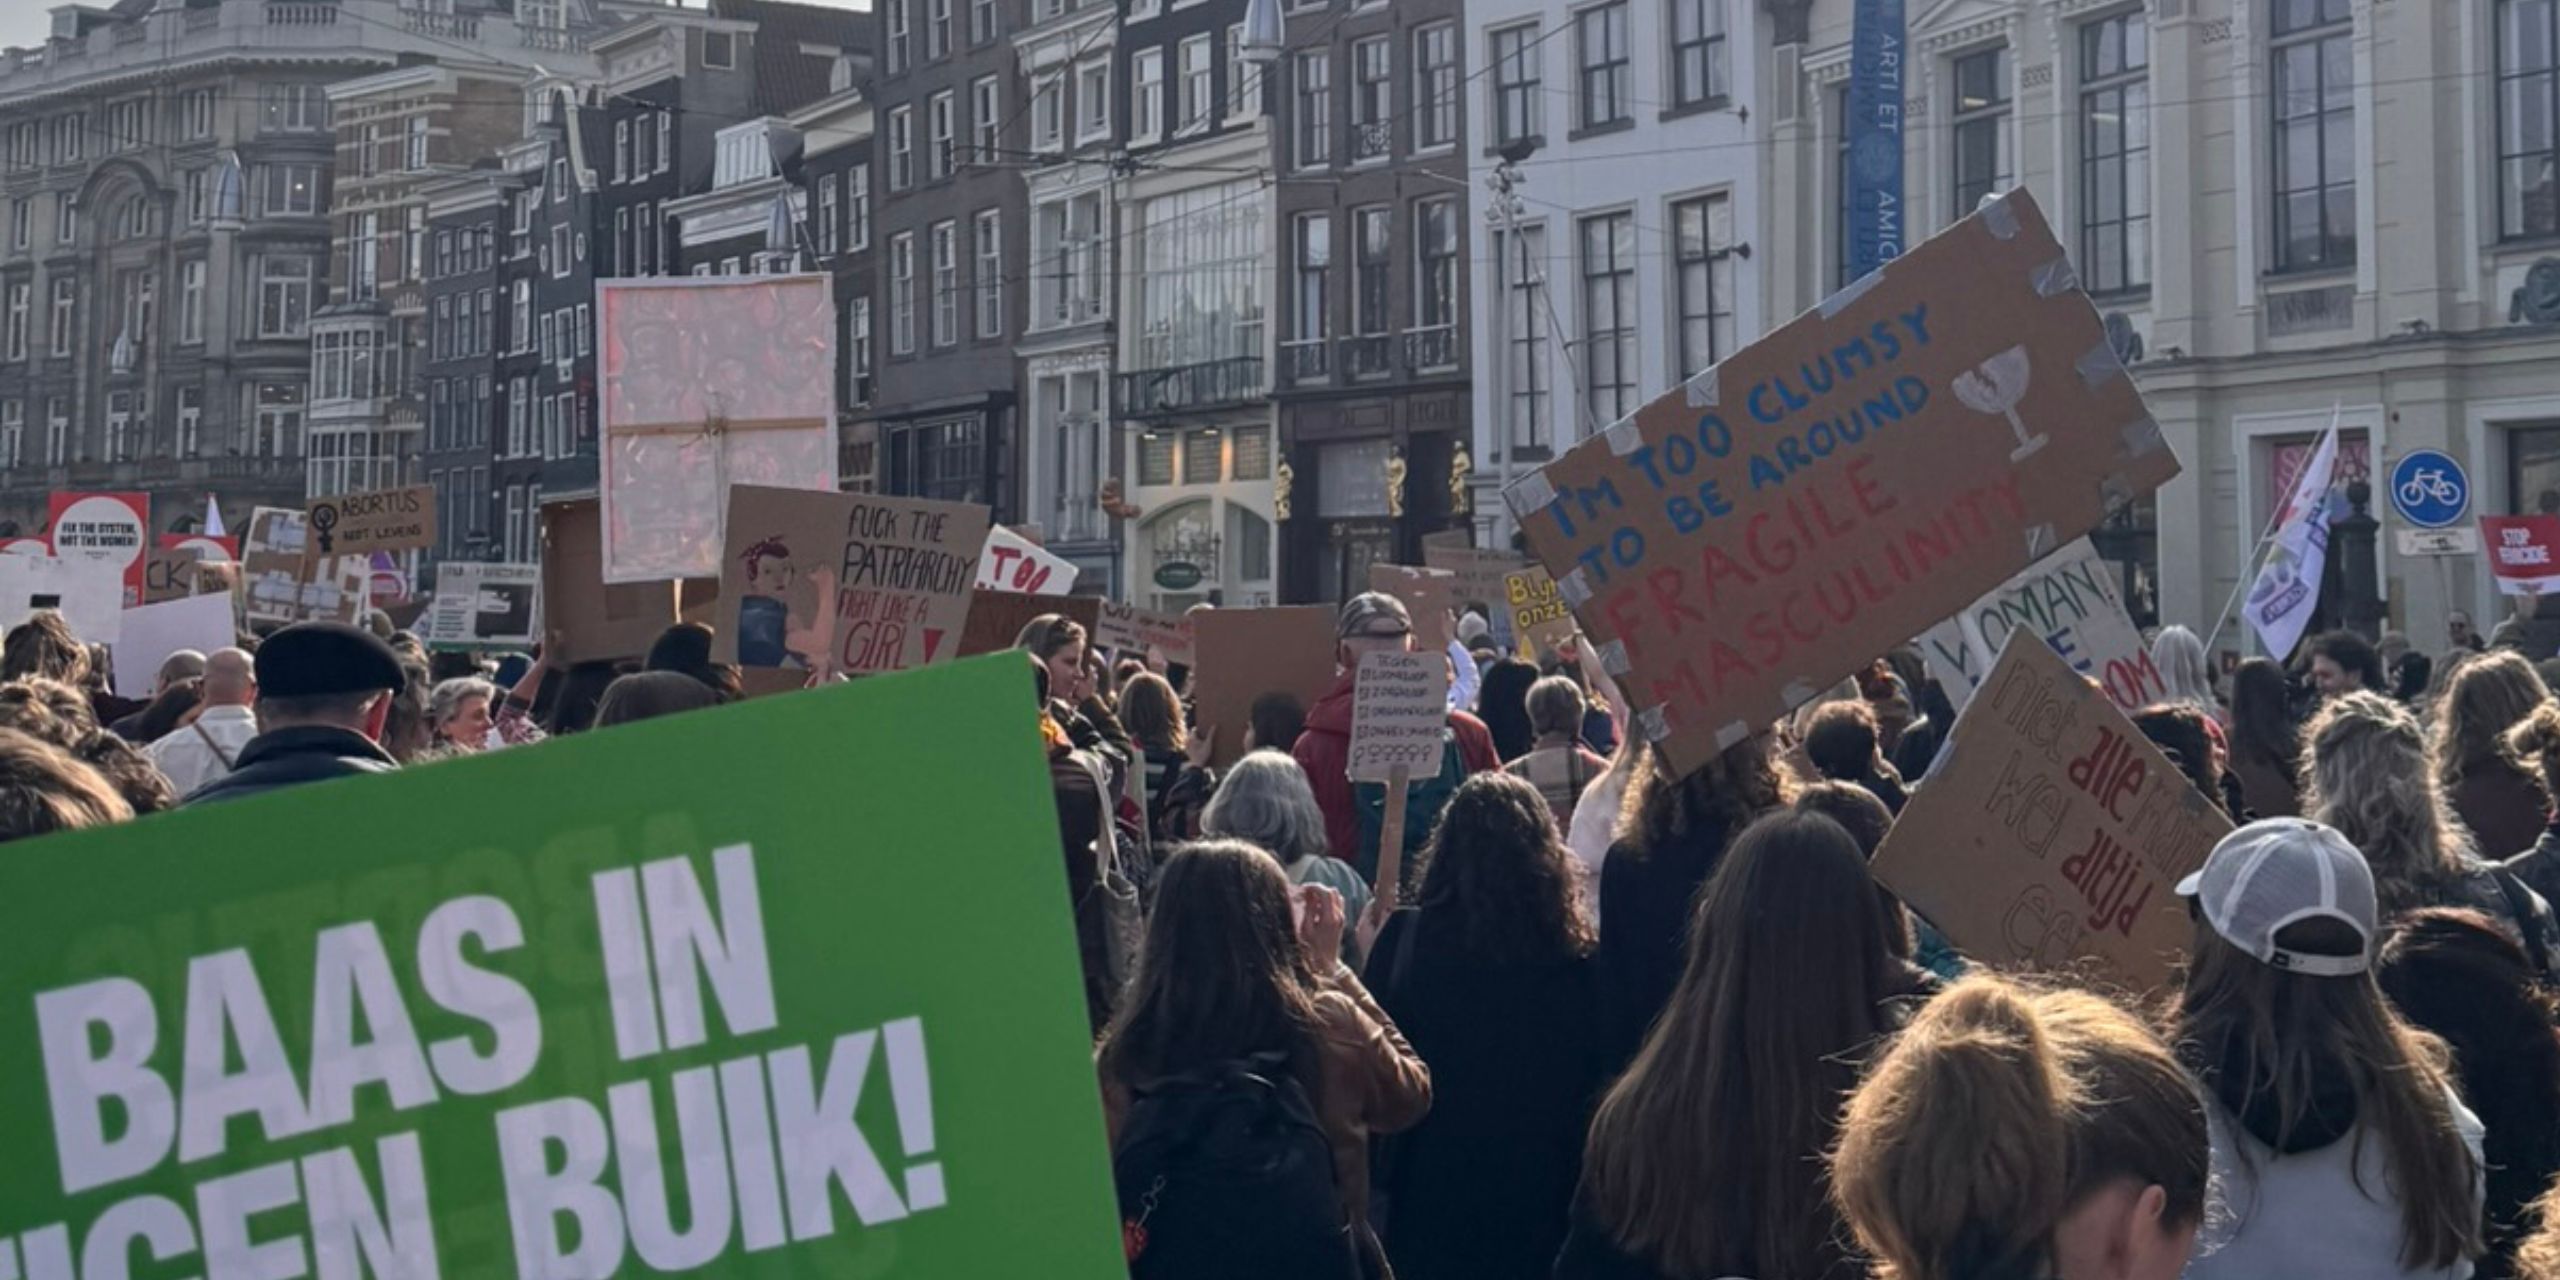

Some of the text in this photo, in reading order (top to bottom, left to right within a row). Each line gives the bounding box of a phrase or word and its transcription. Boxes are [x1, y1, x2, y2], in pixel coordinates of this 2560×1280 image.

[1879, 33, 1898, 91] ARTI
[1878, 103, 1898, 133] ET
[1547, 303, 1932, 539] I'M TOO CLUMSY
[341, 489, 420, 517] ABORTUS
[1577, 374, 1930, 583] TO BE AROUND
[59, 535, 77, 547] NOT
[80, 535, 97, 546] THE
[61, 522, 77, 533] FIX
[79, 522, 95, 533] THE
[848, 504, 949, 543] FUCK THE
[841, 541, 977, 596] PATRIARCHY
[1605, 453, 1898, 657] FRAGILE
[836, 587, 928, 622] FIGHT LIKE A
[1652, 472, 2029, 724] MASCULINITY
[842, 619, 909, 670] GIRL
[1376, 653, 1420, 668] TEGEN
[1992, 657, 2077, 762] niet
[2068, 725, 2146, 823] alle
[1985, 750, 2154, 936] wel altijd
[34, 841, 778, 1195] BAAS IN
[494, 1014, 946, 1280] BUIK!
